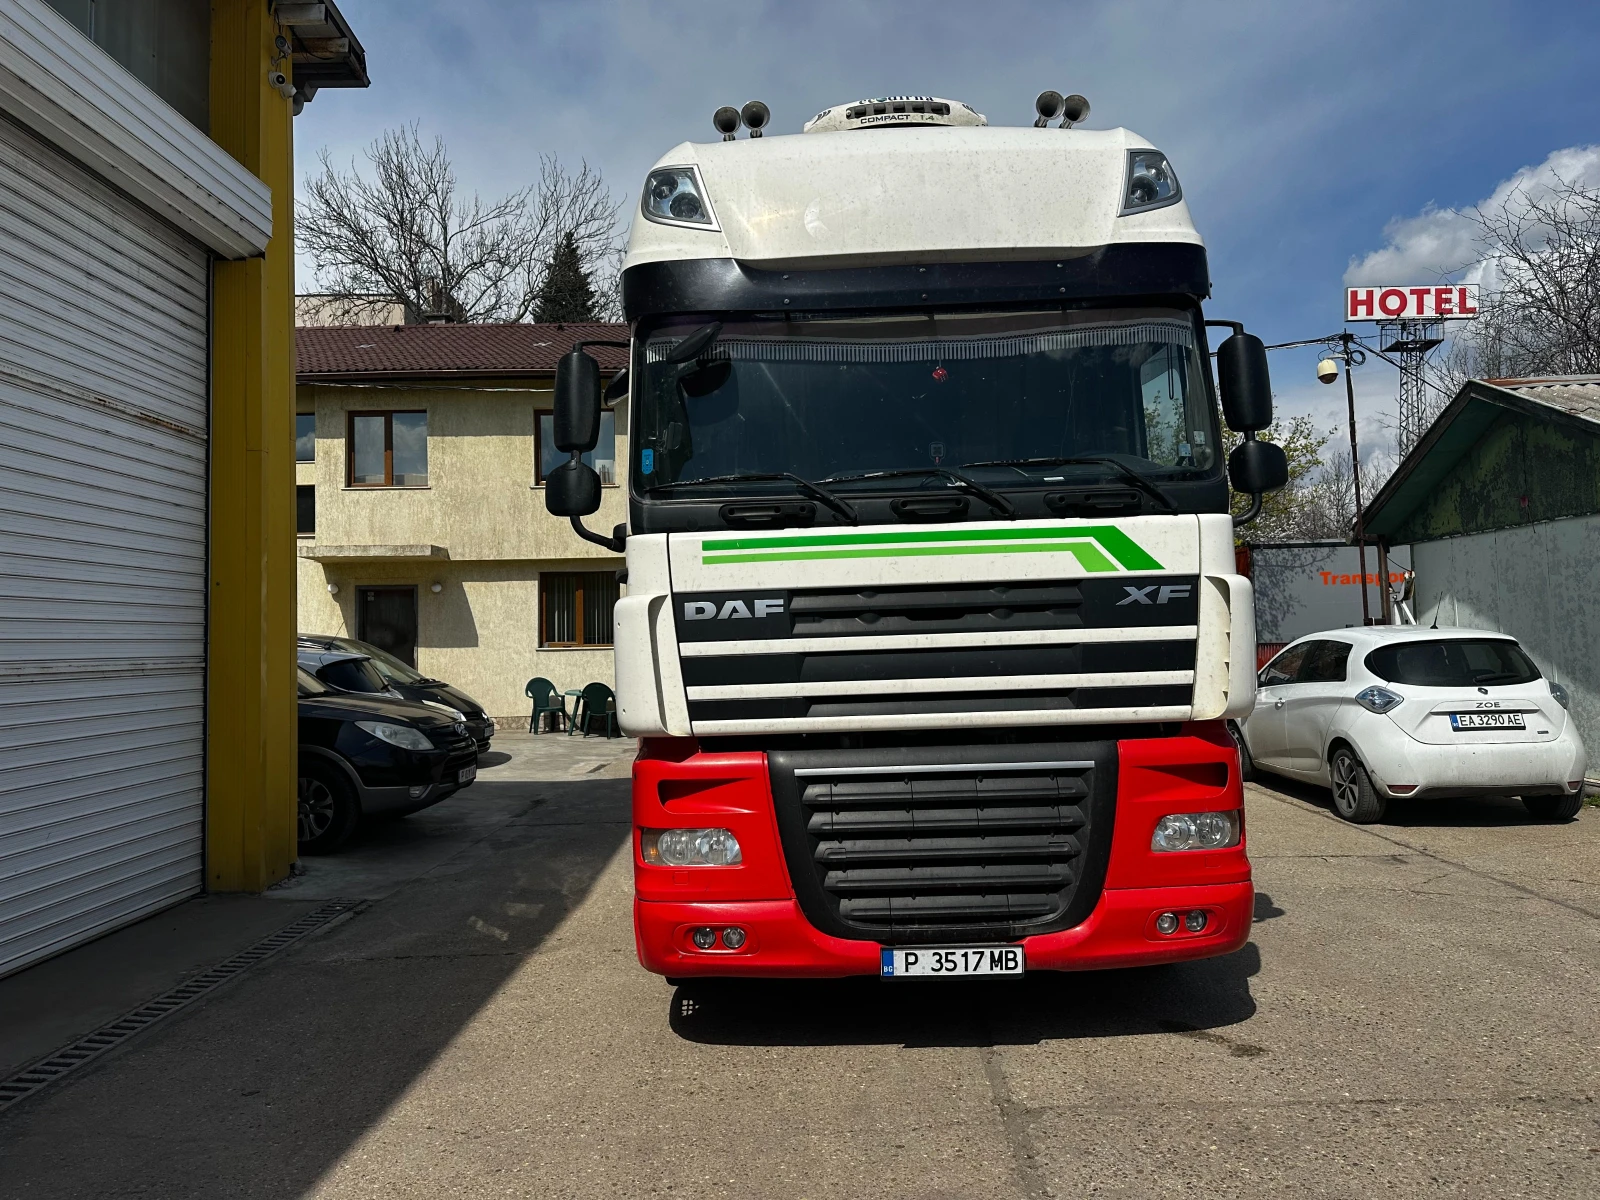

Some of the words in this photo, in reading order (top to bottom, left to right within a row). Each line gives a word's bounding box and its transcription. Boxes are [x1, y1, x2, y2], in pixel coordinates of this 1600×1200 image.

[860, 114, 910, 124] COMPACT
[1350, 288, 1477, 316] HOTEL
[1320, 571, 1411, 586] Transpor
[1115, 585, 1192, 605] XF
[684, 599, 784, 620] DAF
[1460, 715, 1476, 726] EA
[1479, 714, 1505, 726] 3290
[1507, 714, 1522, 725] AE
[904, 952, 919, 973] P
[931, 951, 985, 972] 3517
[990, 950, 1019, 971] MB
